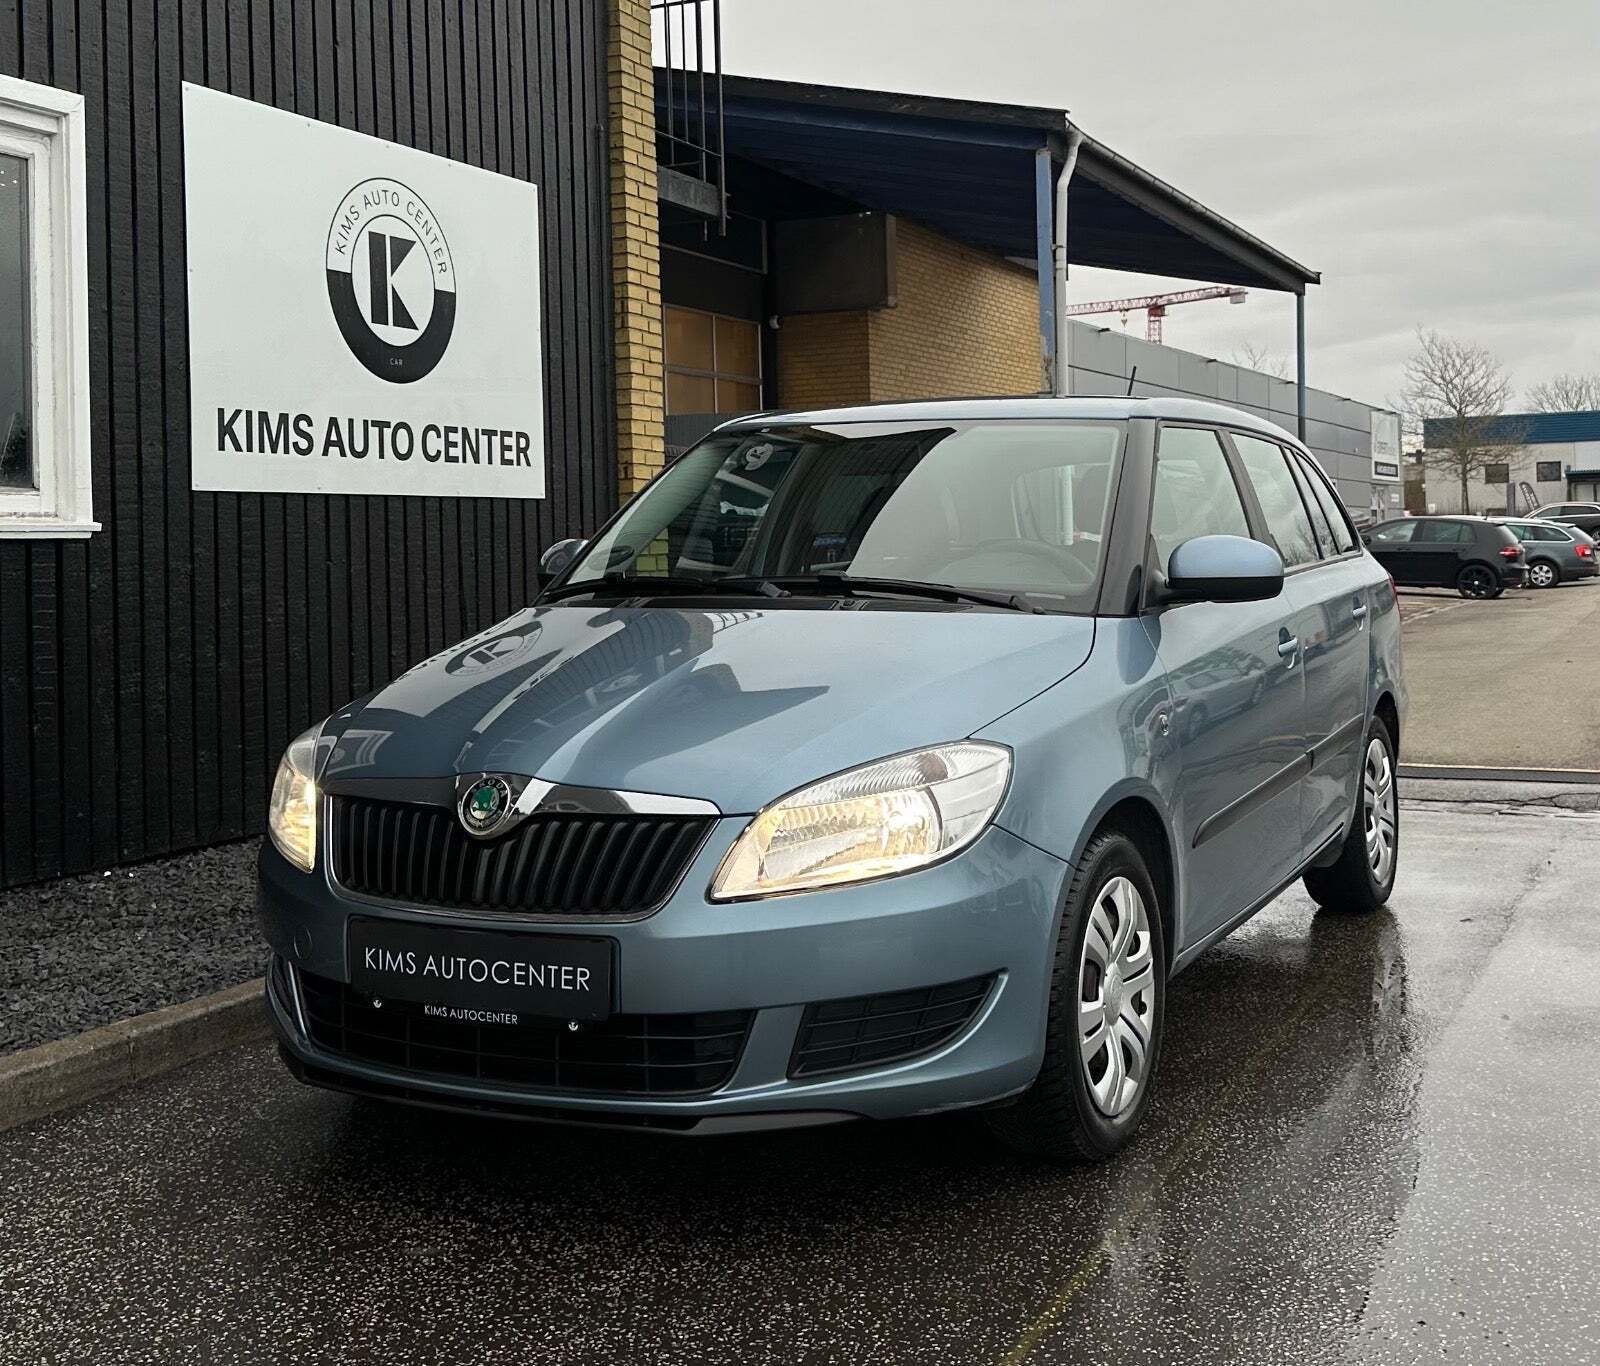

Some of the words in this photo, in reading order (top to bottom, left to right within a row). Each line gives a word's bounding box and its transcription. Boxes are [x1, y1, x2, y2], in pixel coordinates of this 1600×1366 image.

[334, 205, 360, 255] KIMS
[364, 189, 400, 209] AUTO
[406, 201, 448, 274] CENTER
[368, 230, 419, 331] K
[217, 407, 315, 457] KIMS
[321, 416, 415, 462] AUTO
[421, 423, 532, 468] CENTER
[365, 947, 416, 975] KIMS
[423, 954, 591, 991] AUTOCENTER
[424, 1005, 448, 1017] KIMS
[449, 1008, 518, 1025] AUTOCENTER
